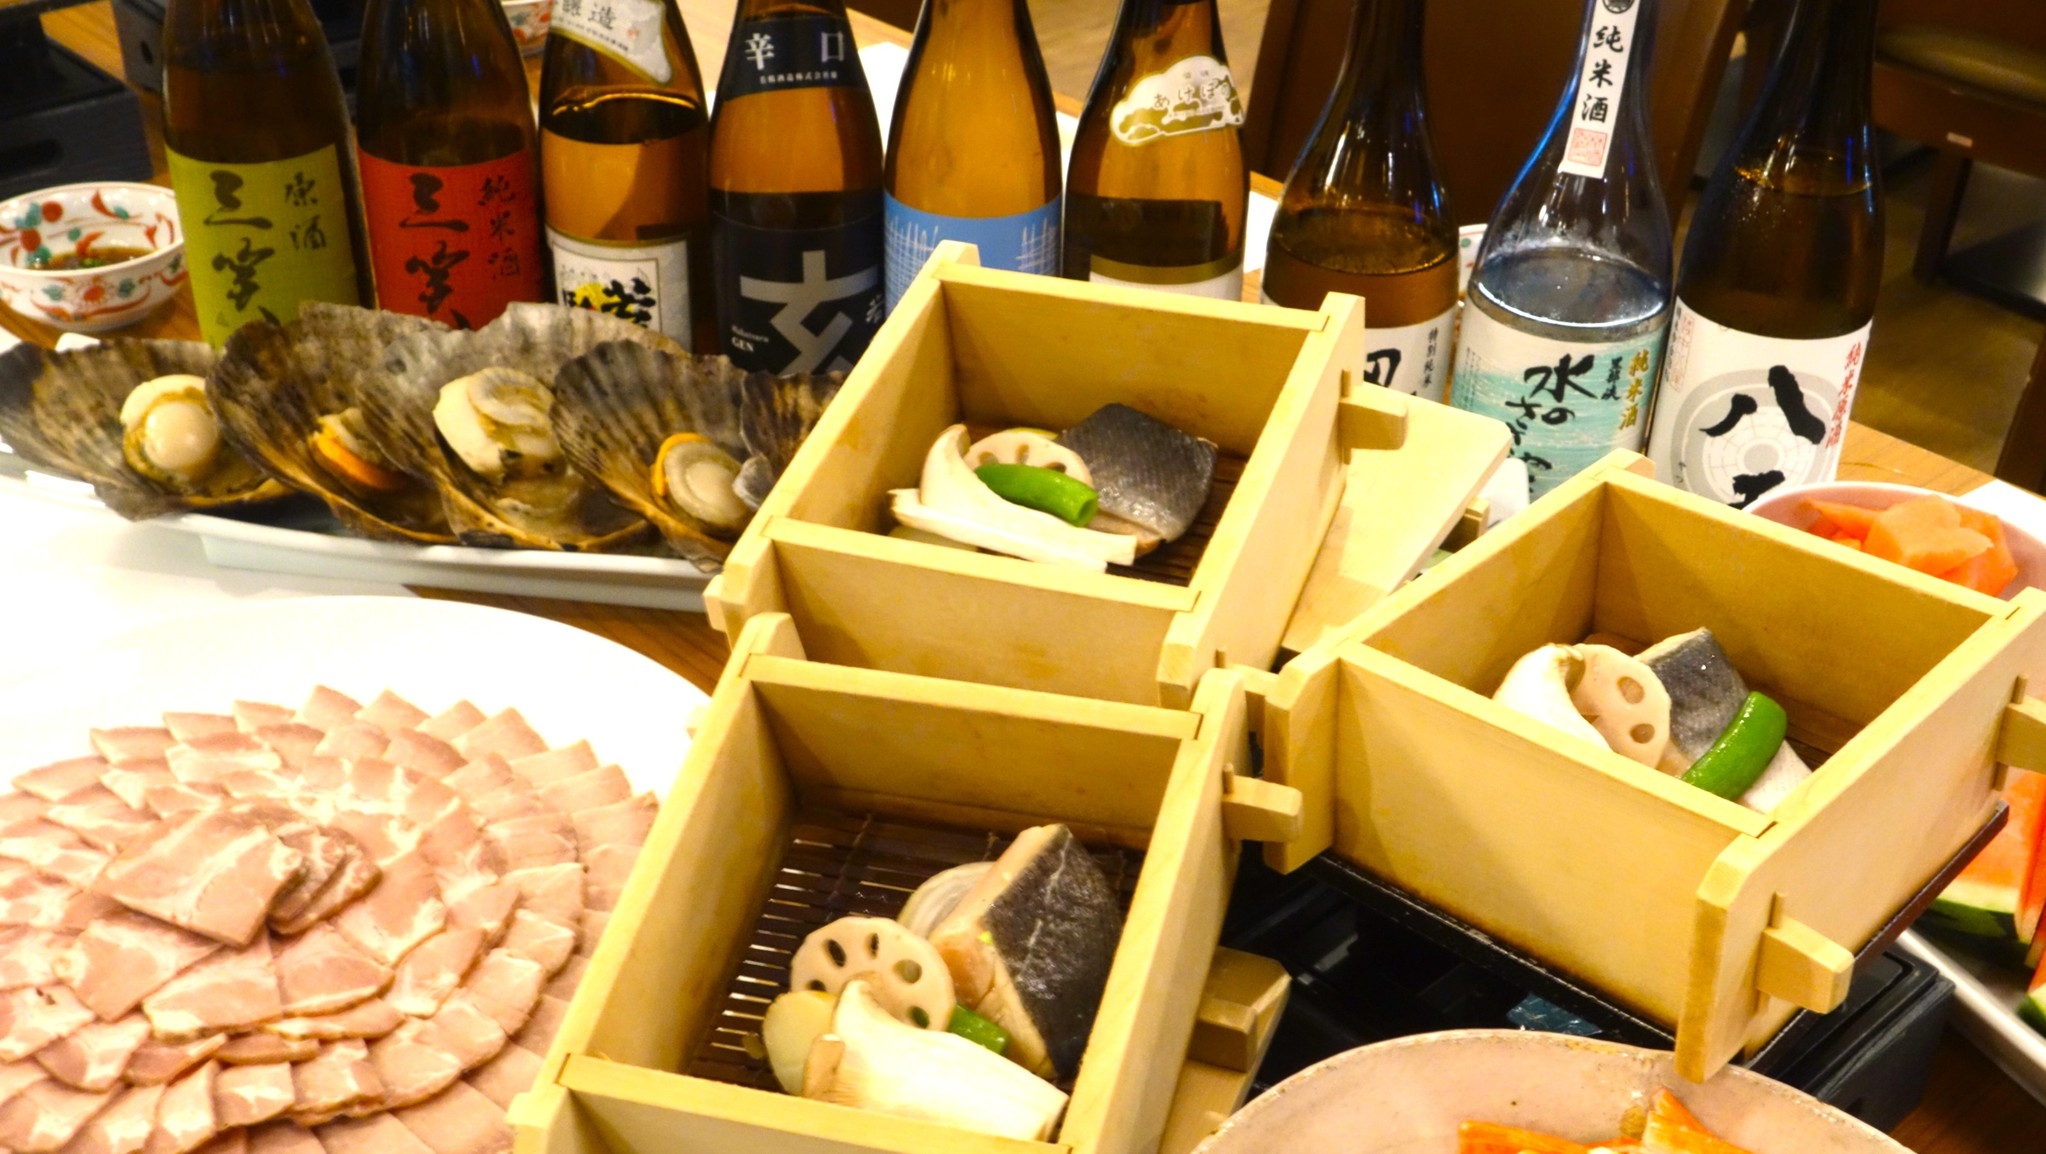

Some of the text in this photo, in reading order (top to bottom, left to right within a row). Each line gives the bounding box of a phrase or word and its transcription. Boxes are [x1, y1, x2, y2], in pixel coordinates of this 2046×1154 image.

[744, 32, 844, 70] 辛口
[1580, 25, 1624, 124] 純米酒
[731, 336, 754, 352] GEN
[740, 250, 879, 377] 玄
[1619, 349, 1650, 431] 純米酒
[1826, 342, 1862, 449] 純米原酒
